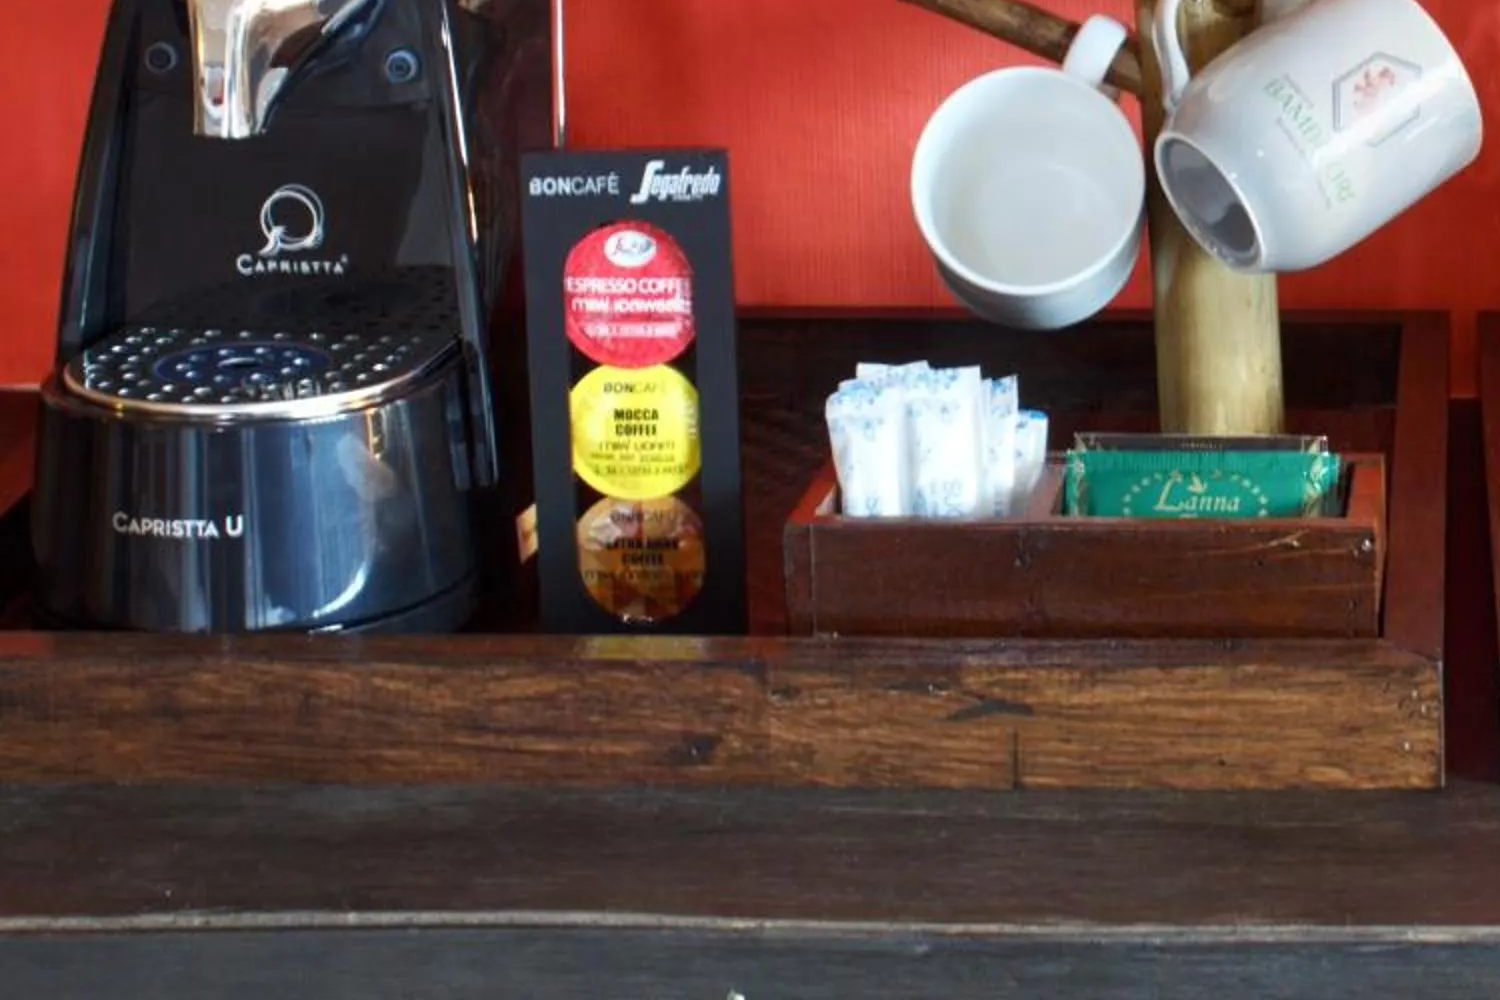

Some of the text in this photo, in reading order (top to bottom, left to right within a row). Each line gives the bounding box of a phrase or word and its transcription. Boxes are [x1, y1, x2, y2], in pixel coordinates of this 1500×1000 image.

[529, 160, 721, 204] BONCAFÉ Segafredo
[613, 408, 659, 421] MOCCA
[615, 423, 657, 437] COFFEE
[1153, 472, 1241, 513] Lanna
[225, 514, 243, 538] U
